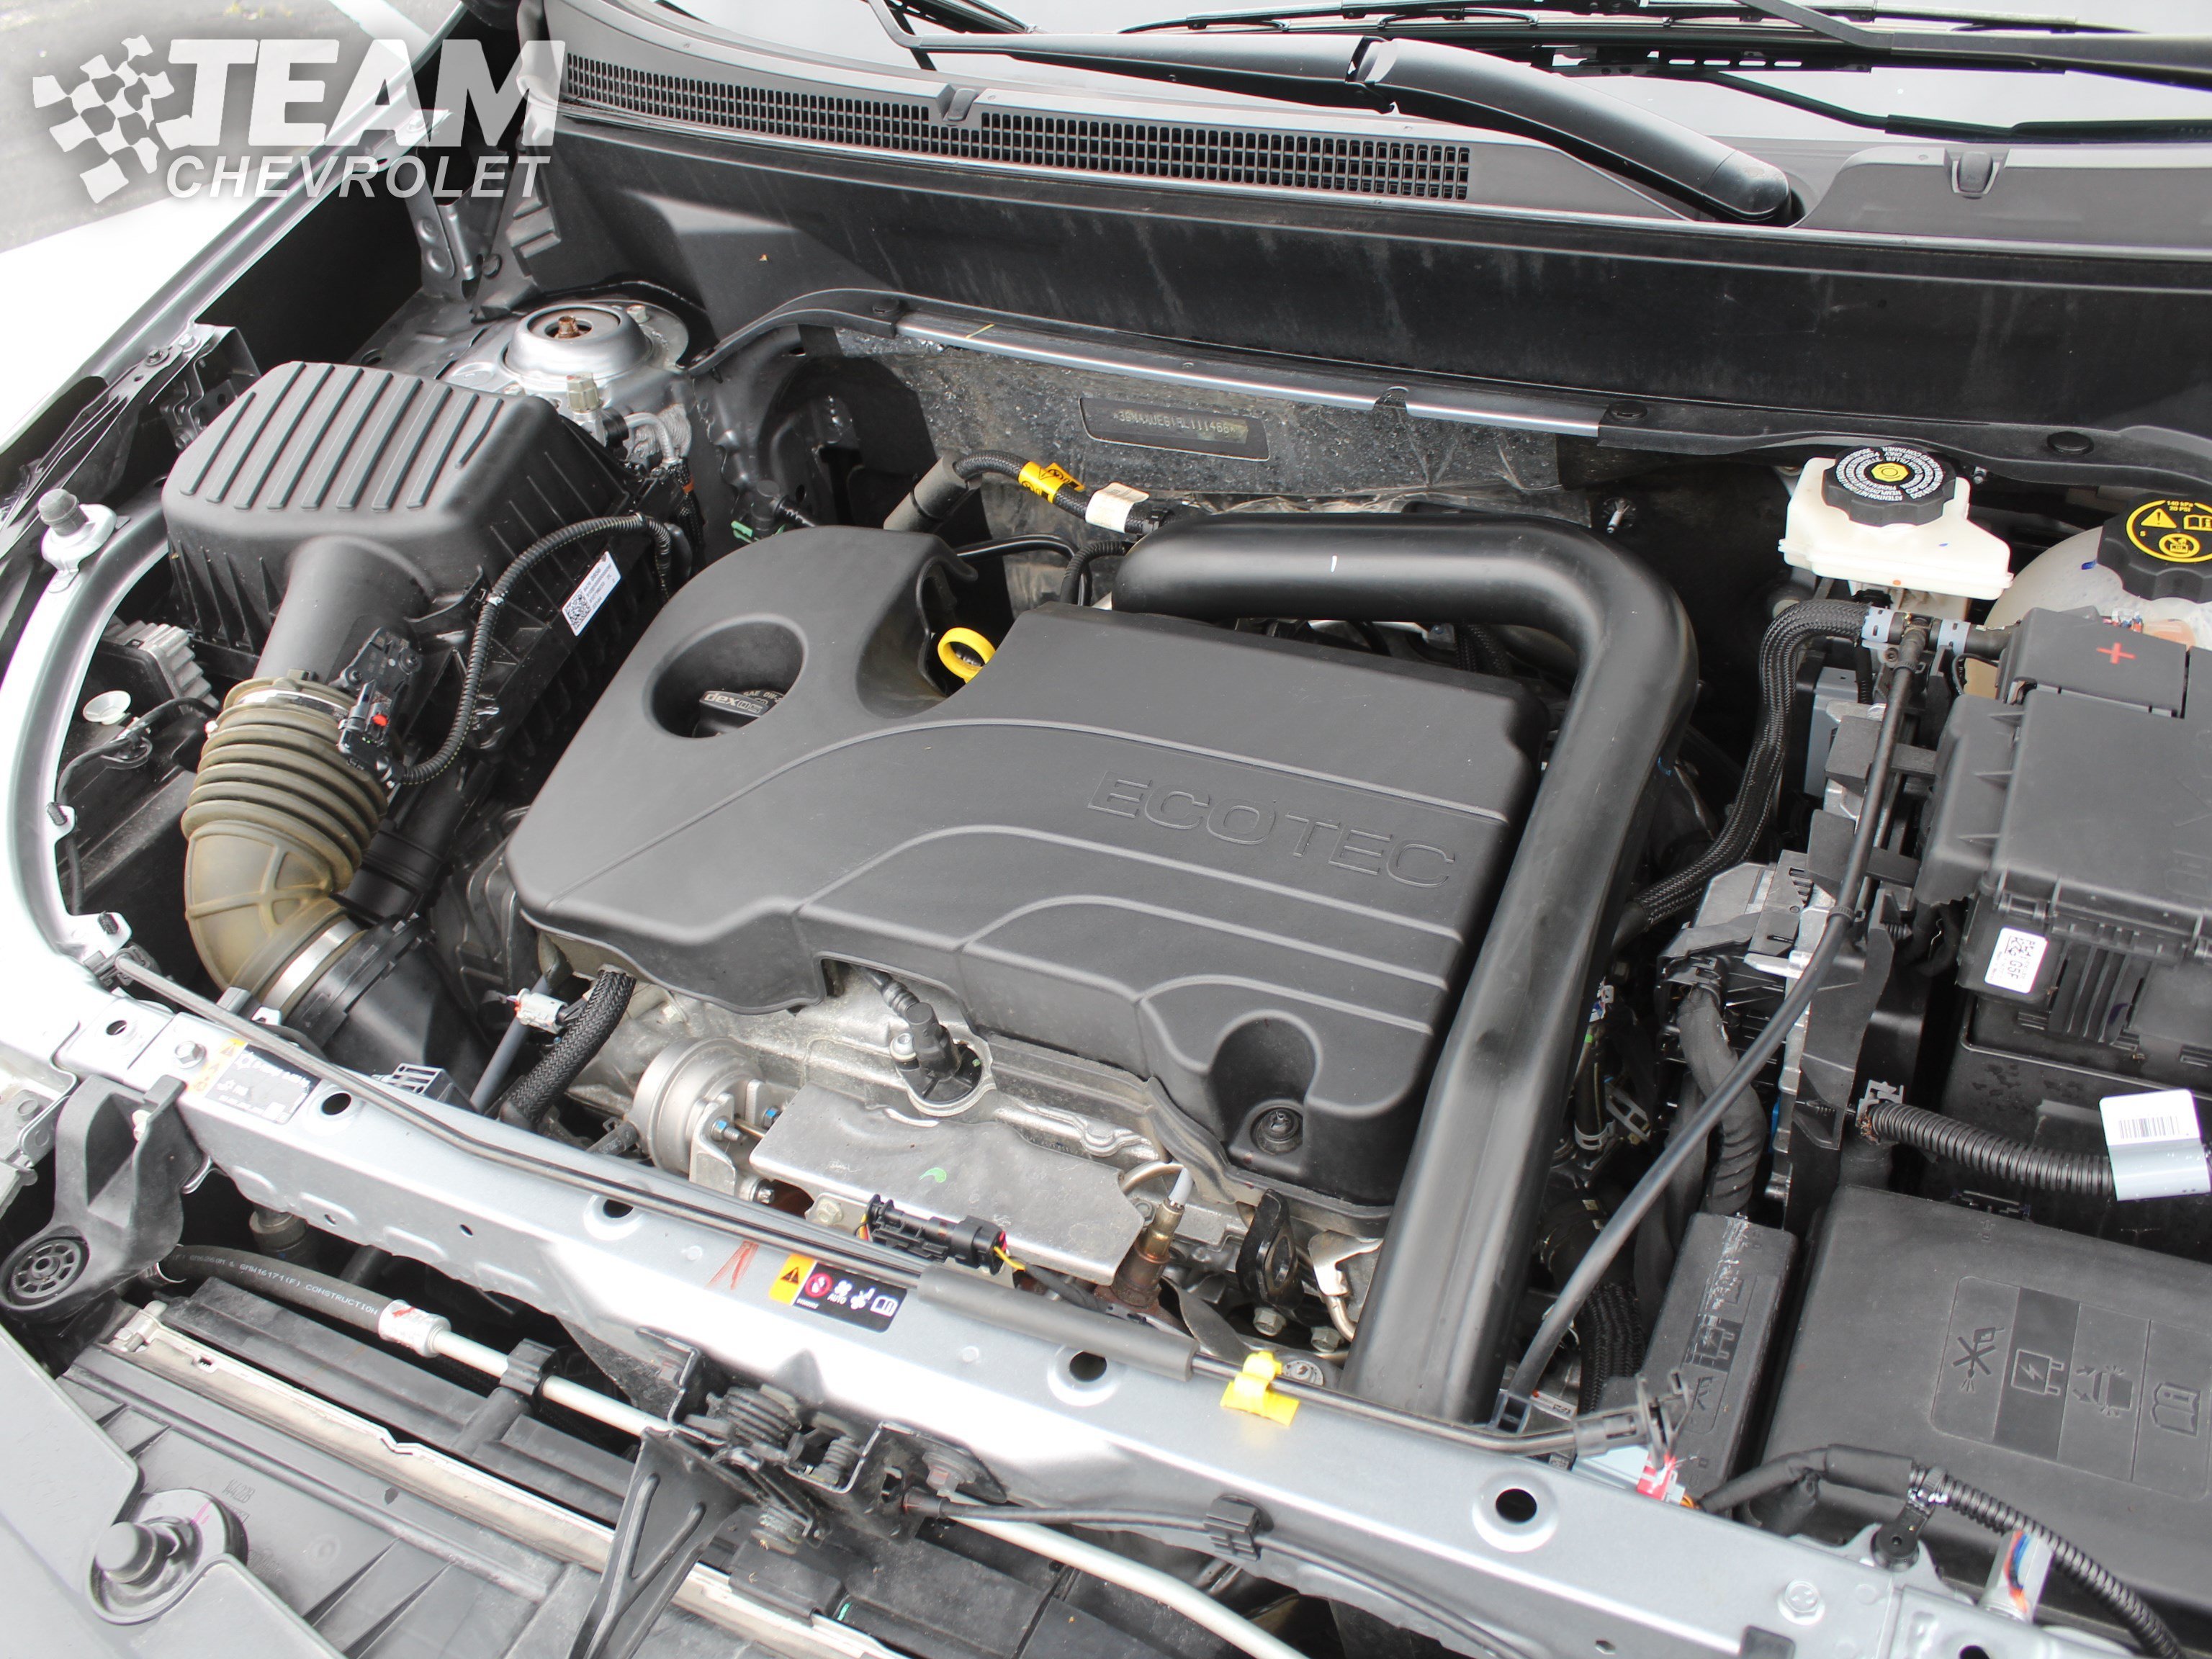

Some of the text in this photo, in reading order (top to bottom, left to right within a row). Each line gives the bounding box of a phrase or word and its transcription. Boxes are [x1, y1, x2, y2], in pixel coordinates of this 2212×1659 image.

[704, 693, 763, 714] dexos
[1088, 770, 1455, 888] ECOTEC
[305, 1284, 379, 1316] CONSTRUCTION
[827, 1292, 848, 1305] AUTO
